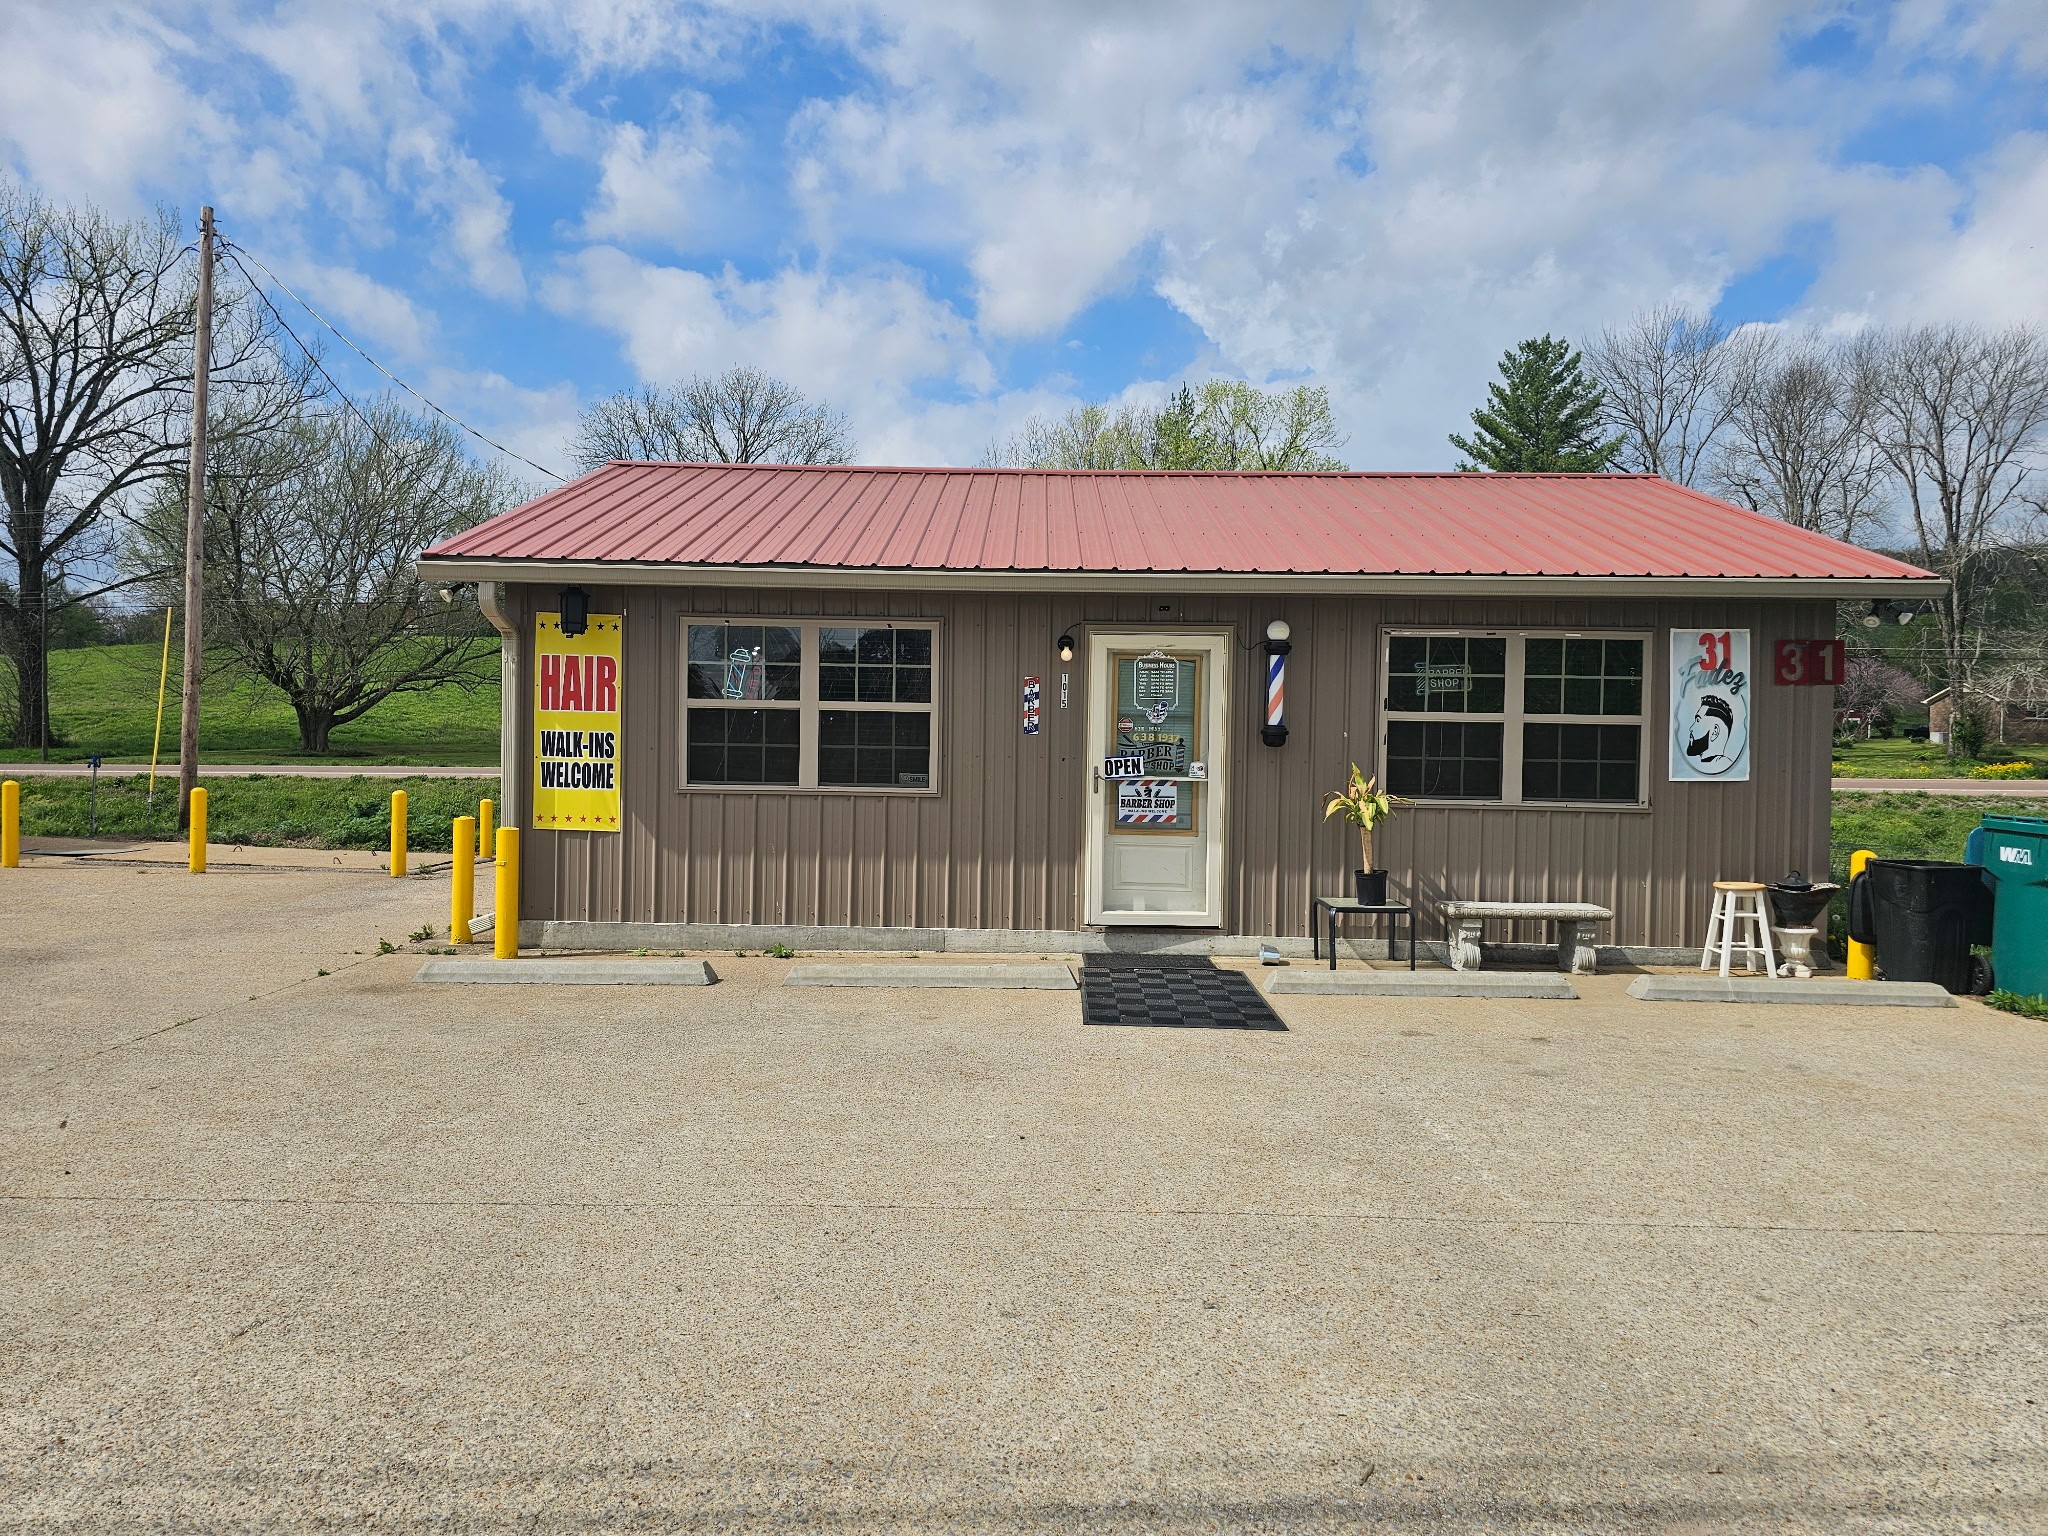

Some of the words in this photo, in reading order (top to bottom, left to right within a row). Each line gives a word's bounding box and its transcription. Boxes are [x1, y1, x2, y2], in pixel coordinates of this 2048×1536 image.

[1698, 632, 1731, 671] 31
[1781, 643, 1834, 682] 31
[540, 654, 617, 712] HAIR
[1430, 679, 1459, 687] SHOP
[1678, 655, 1747, 698] Fadez
[540, 731, 615, 758] WALK-INS
[1133, 733, 1155, 742] 638
[1158, 733, 1181, 743] 1937
[540, 762, 614, 789] WELCOME
[1104, 758, 1142, 777] OPEN
[1151, 761, 1175, 770] SHOP
[1120, 798, 1153, 809] BARBER
[1153, 798, 1176, 809] SHOP
[2000, 846, 2032, 865] WM
